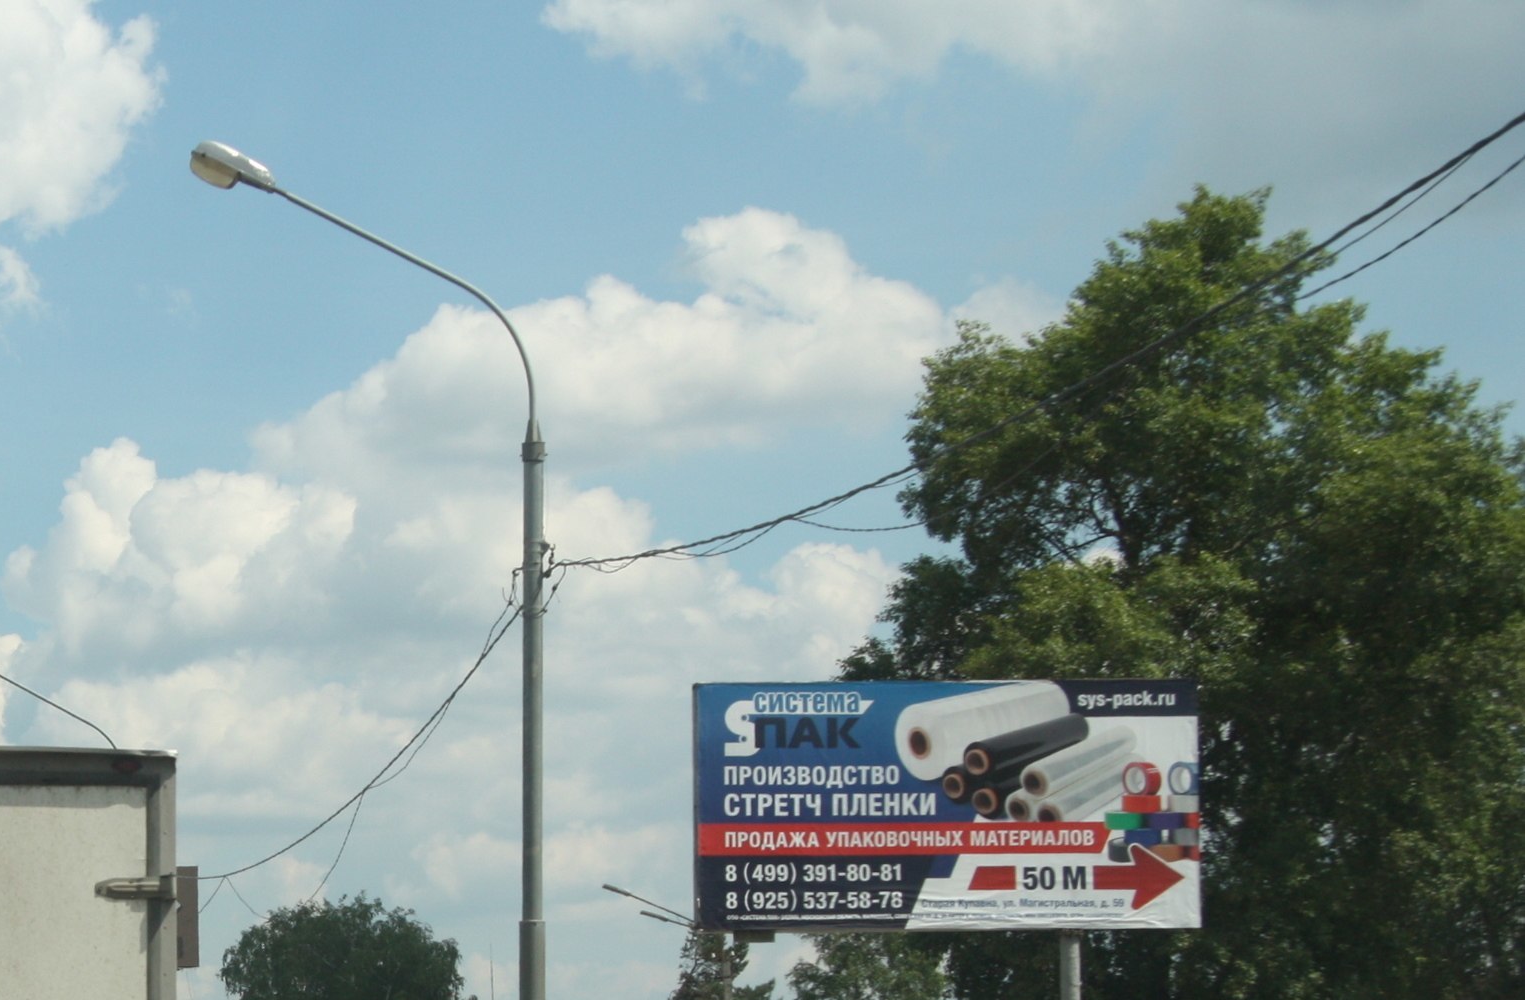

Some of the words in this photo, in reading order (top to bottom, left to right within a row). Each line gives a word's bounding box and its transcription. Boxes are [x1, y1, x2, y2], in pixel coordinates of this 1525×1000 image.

[1077, 690, 1176, 710] sys-pack.ru
[754, 716, 861, 749] ПАК
[724, 765, 900, 789] ПРОИЗВОДСТВО
[724, 793, 821, 817] СТРЕТЧ
[832, 792, 936, 817] ПЛЕНКИ
[724, 831, 820, 850] ПРОДАЖА
[826, 830, 963, 848] УПАКОВОЧНЫХ
[970, 829, 1095, 847] МАТЕРИАЛОВ
[725, 864, 737, 882] 8
[743, 862, 797, 885] (499)
[802, 863, 902, 882] 391-80-81
[1023, 866, 1056, 890] 50
[726, 891, 738, 909] 8
[744, 889, 797, 911] (925)
[803, 890, 903, 909] 537-58-78
